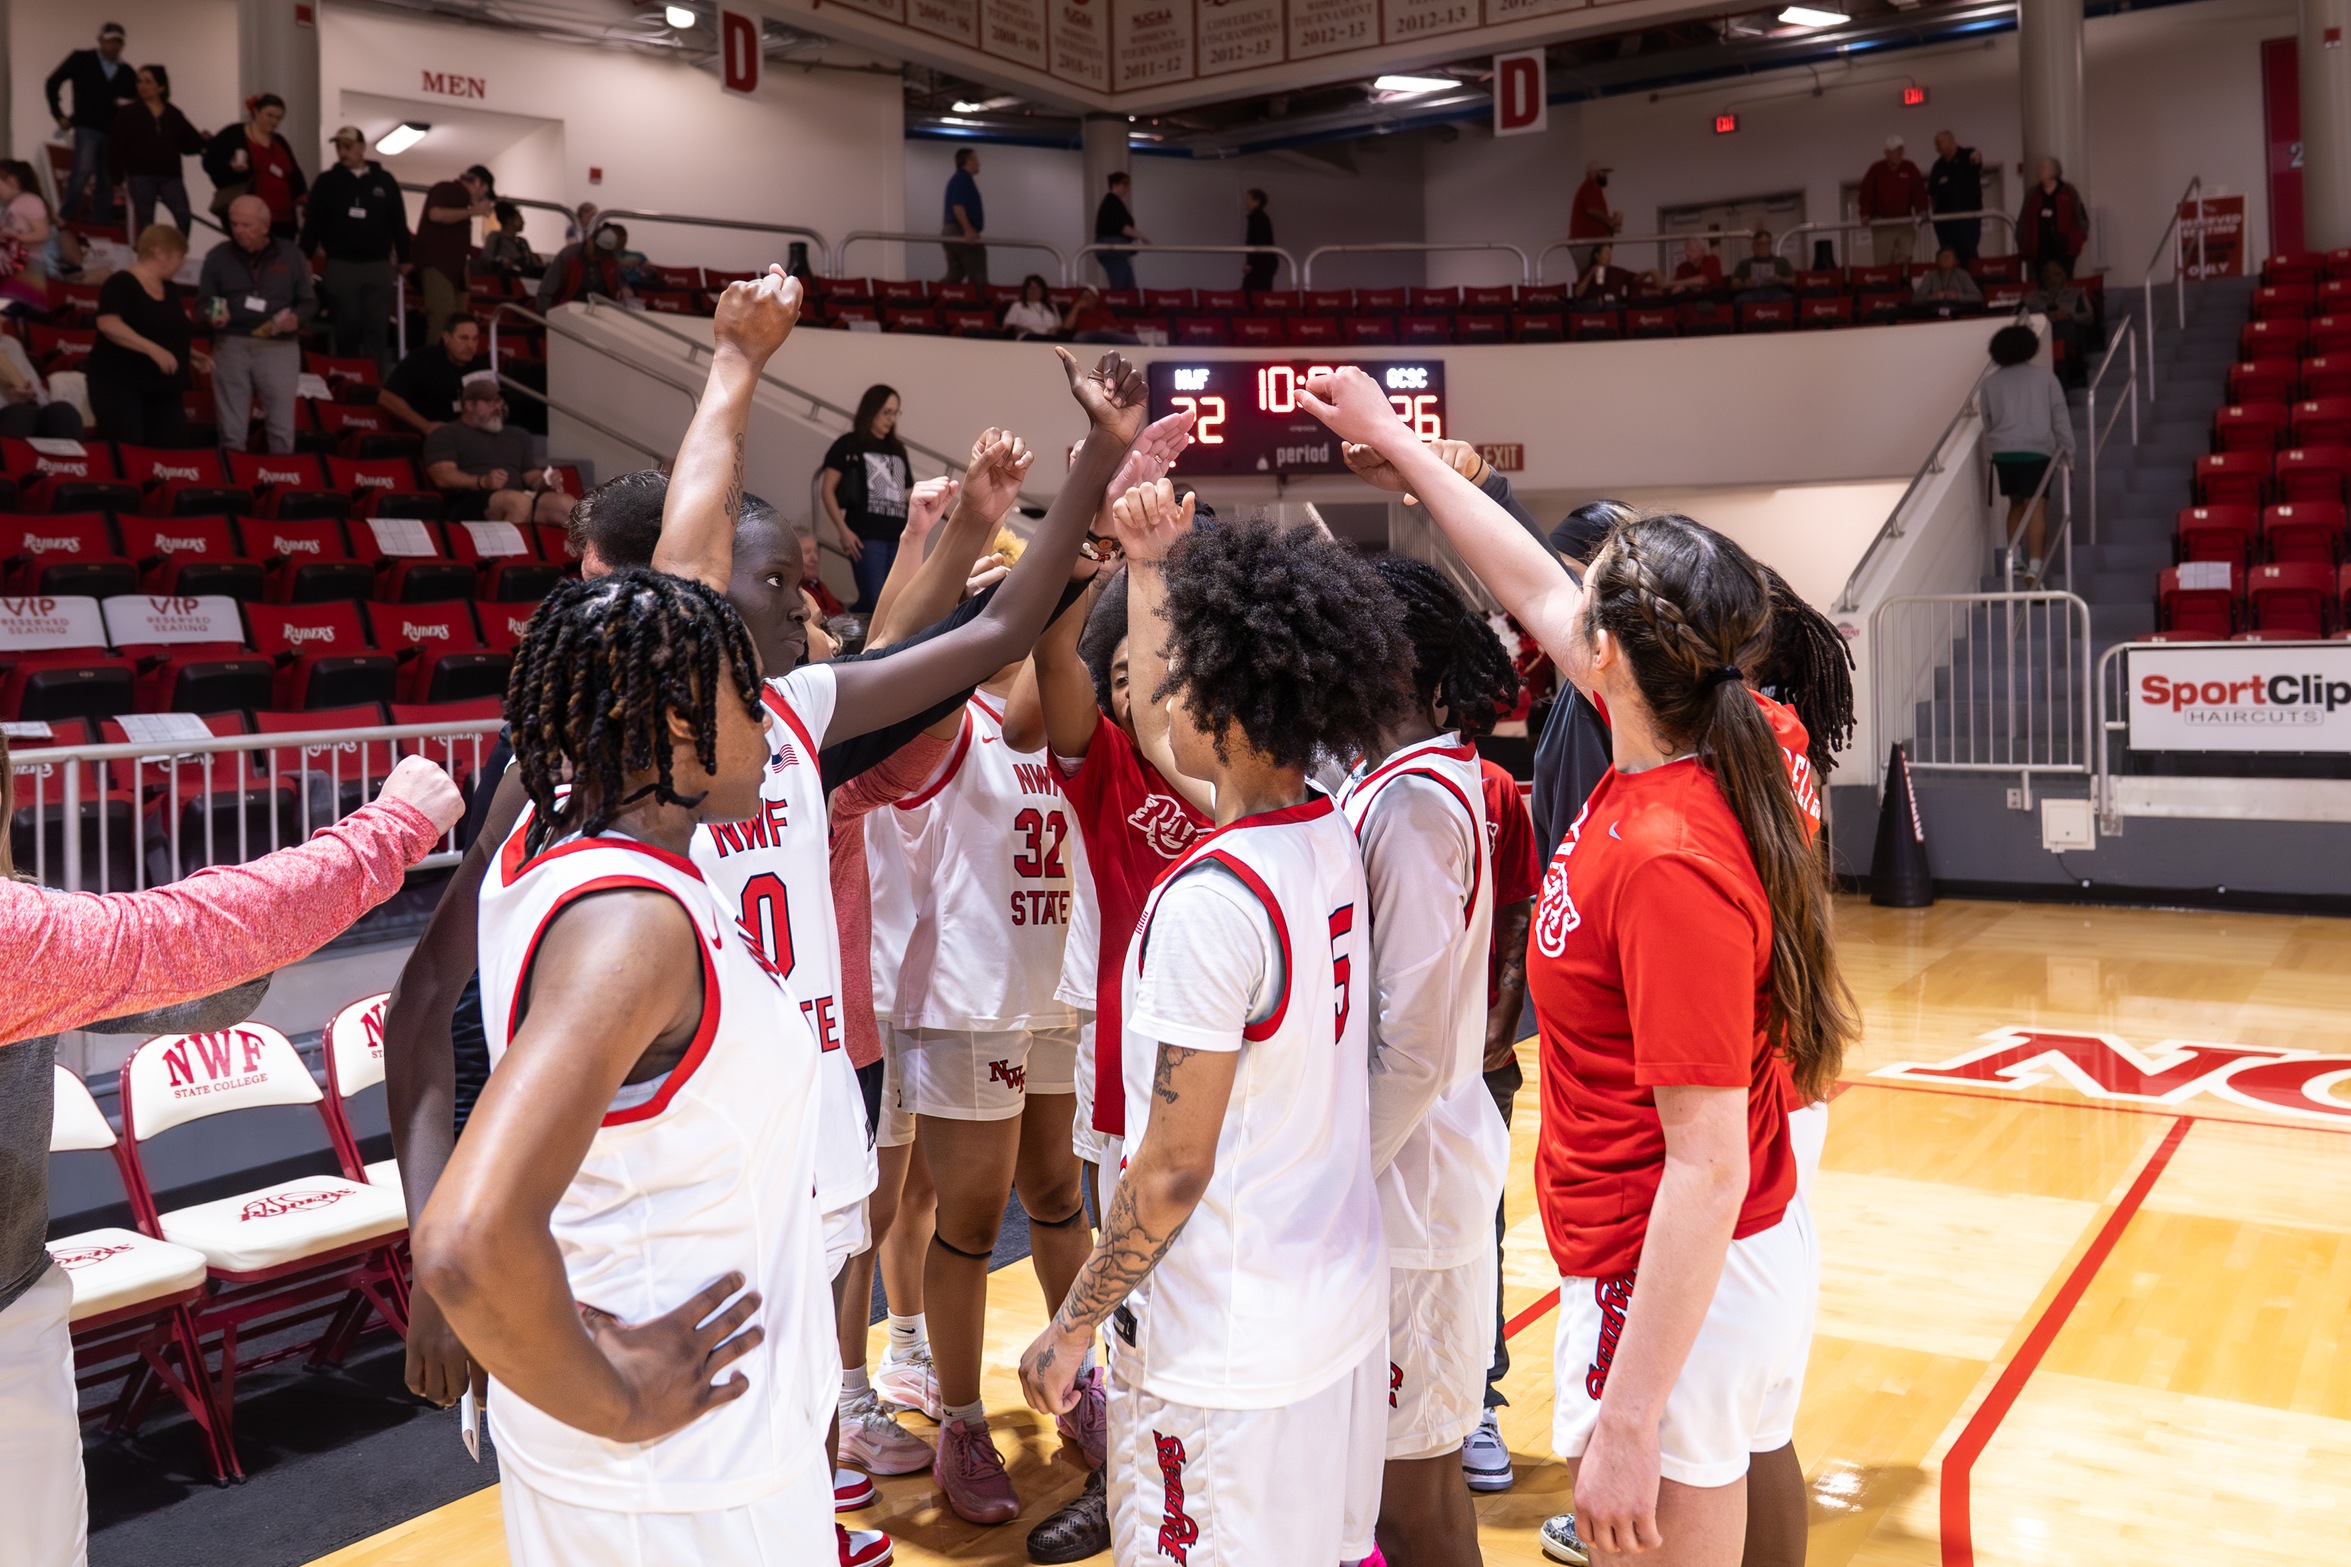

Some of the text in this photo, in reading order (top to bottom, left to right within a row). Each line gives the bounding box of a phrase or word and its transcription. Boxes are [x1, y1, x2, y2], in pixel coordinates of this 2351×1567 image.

[1396, 6, 1466, 33] 2012-13
[1300, 21, 1366, 47] 2012-13
[723, 10, 758, 94] D
[1209, 39, 1271, 64] 2012-13
[421, 70, 486, 99] MEN
[1501, 56, 1540, 130] D
[1276, 441, 1330, 468] period
[4, 597, 56, 617] VIP
[150, 597, 200, 616] VIP
[2189, 710, 2319, 724] HAIRCUTS
[708, 798, 788, 859] NWF
[1013, 807, 1069, 879] 32
[1010, 890, 1071, 926] STATE
[161, 1028, 266, 1088] NWF
[174, 1073, 269, 1099] STATE COLLEGE
